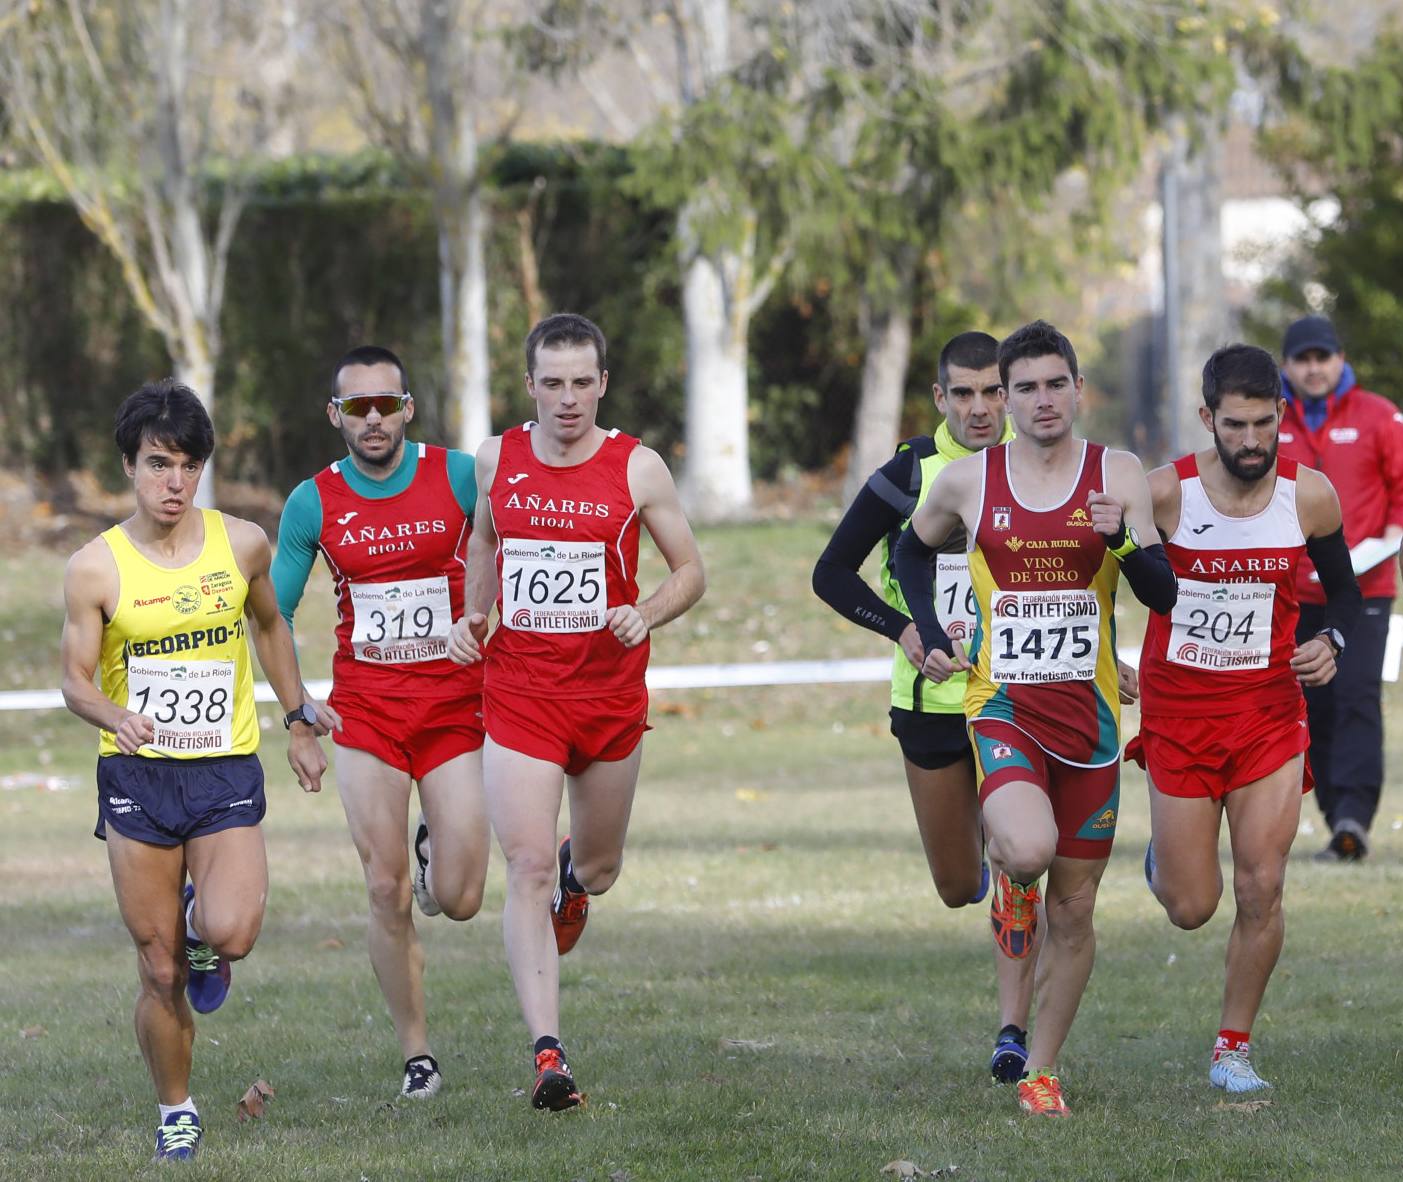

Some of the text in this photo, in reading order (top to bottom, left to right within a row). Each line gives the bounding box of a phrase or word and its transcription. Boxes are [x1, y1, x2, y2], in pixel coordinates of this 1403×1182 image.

[504, 493, 609, 518] AÑARES
[530, 516, 575, 529] RIOJA
[338, 519, 447, 546] AÑARES
[368, 540, 415, 556] RIOJA
[1026, 539, 1080, 549] CAJA RURAL
[504, 548, 540, 558] Gobierno
[557, 551, 567, 559] de
[1022, 556, 1064, 569] VINO
[1190, 557, 1289, 574] AÑARES
[1009, 570, 1079, 583] DE TORO
[352, 586, 447, 600] Gobierno de La Rioja
[508, 567, 600, 604] 1625
[133, 595, 172, 608] Alcampo
[1229, 593, 1239, 601] de
[1240, 592, 1251, 600] La
[1252, 591, 1272, 600] Rioja
[534, 609, 566, 617] FEDERACIÓN
[567, 609, 590, 617] RIOJANA
[853, 605, 887, 627] KIPSTA
[1022, 601, 1097, 618] ATLETISMO
[366, 605, 434, 643] 319
[534, 615, 599, 629] ATLETISMO
[1186, 608, 1256, 644] 204
[999, 625, 1092, 660] 1475
[384, 644, 447, 661] ATLETISMO
[1200, 652, 1261, 667] ATLETISMO
[129, 665, 232, 679] Gobierno de La Rioja
[993, 669, 1094, 681] www.fratletismo.com
[136, 686, 228, 725] 1338
[158, 735, 222, 750] ATLETISMO
